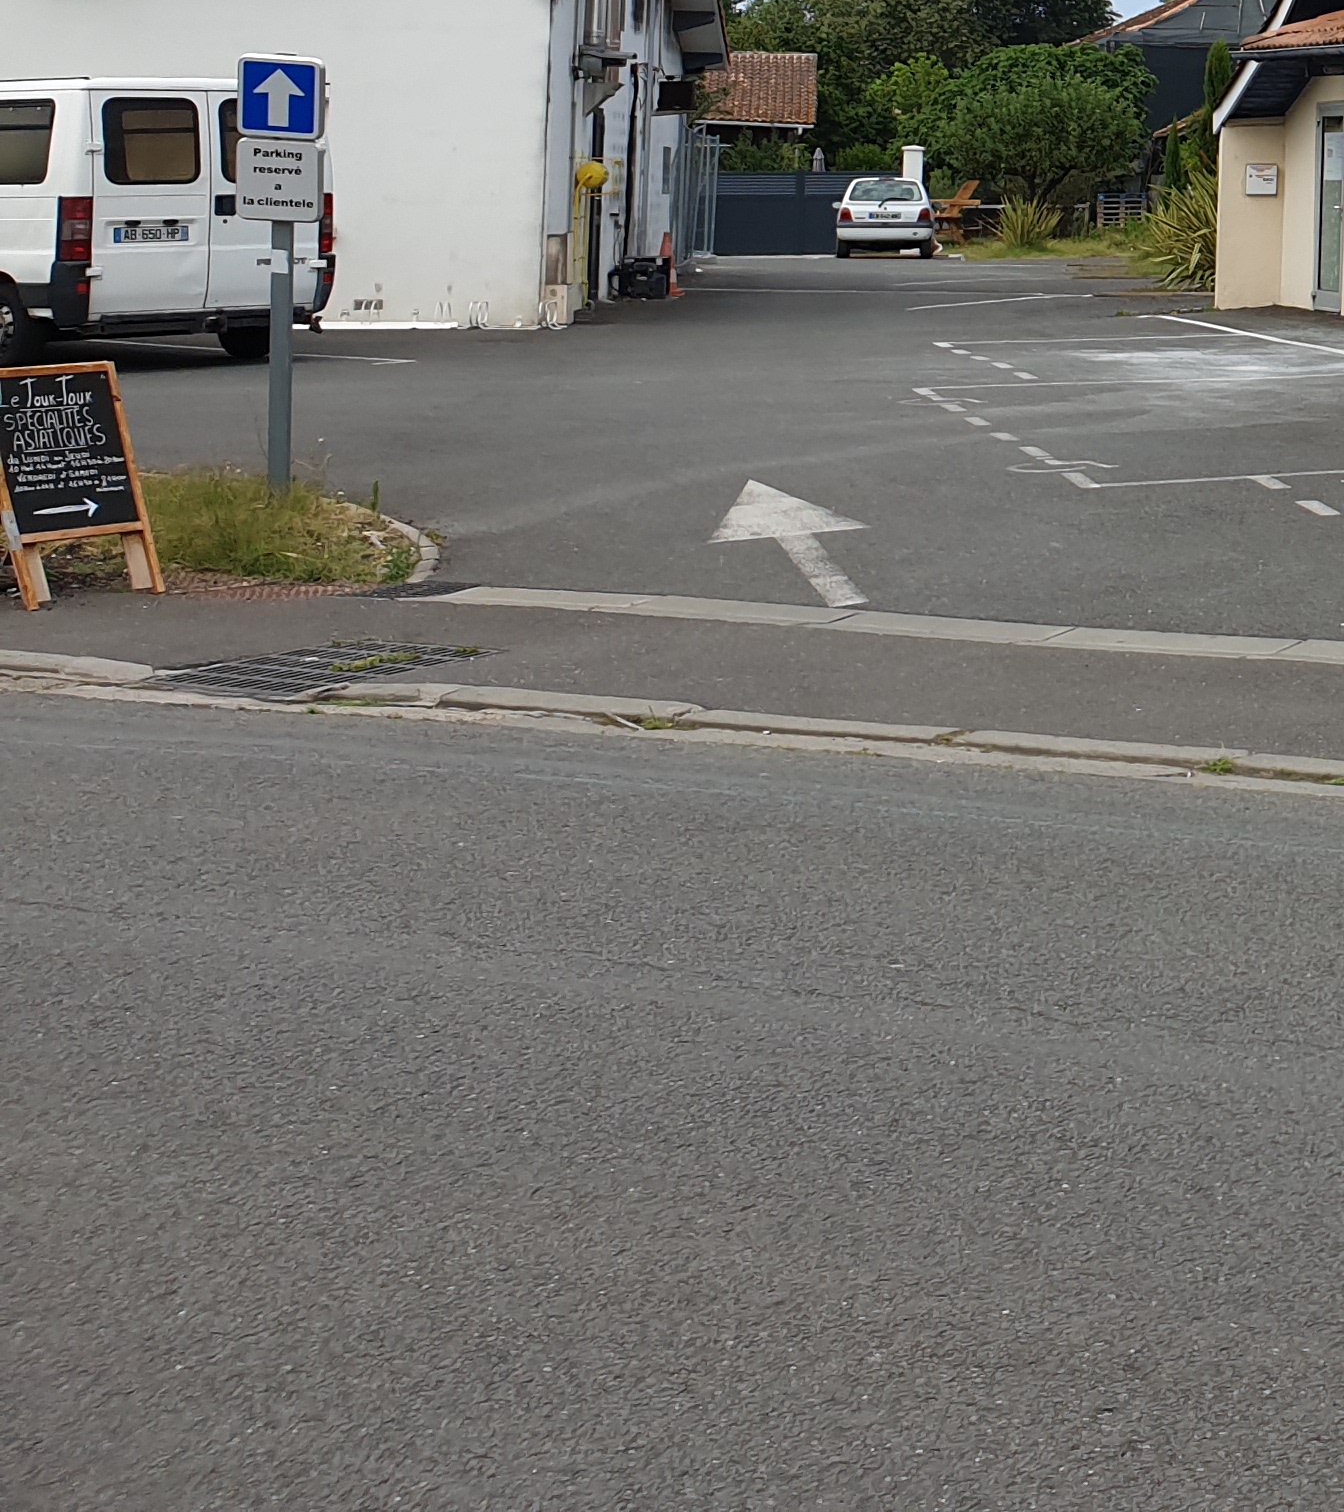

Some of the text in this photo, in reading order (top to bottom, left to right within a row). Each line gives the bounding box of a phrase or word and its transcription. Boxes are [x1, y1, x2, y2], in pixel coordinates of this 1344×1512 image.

[253, 148, 303, 161] Parking
[243, 196, 254, 205] la
[13, 424, 106, 452] ASIATIQUES
